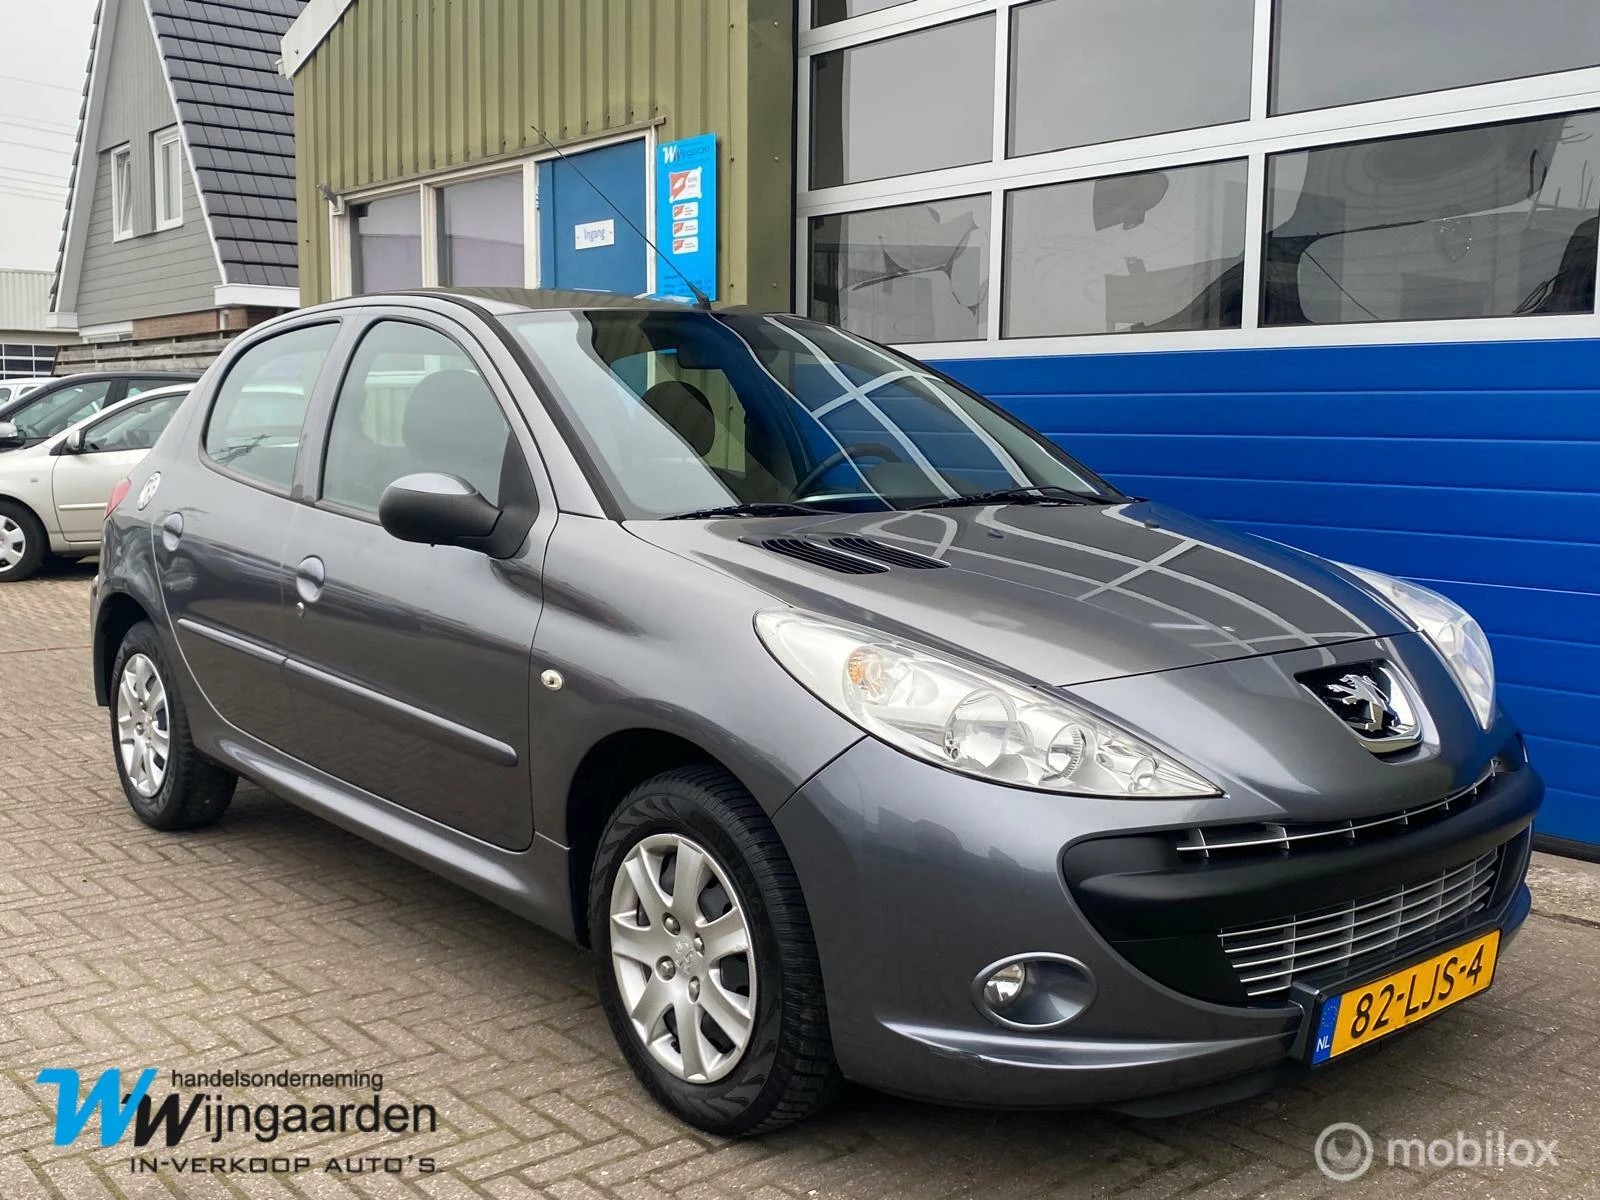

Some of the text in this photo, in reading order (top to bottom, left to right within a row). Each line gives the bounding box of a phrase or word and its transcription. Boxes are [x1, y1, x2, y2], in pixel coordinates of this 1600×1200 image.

[583, 228, 605, 242] Ingang
[1350, 944, 1485, 1039] 82-LJS-4
[1316, 1035, 1330, 1053] NL
